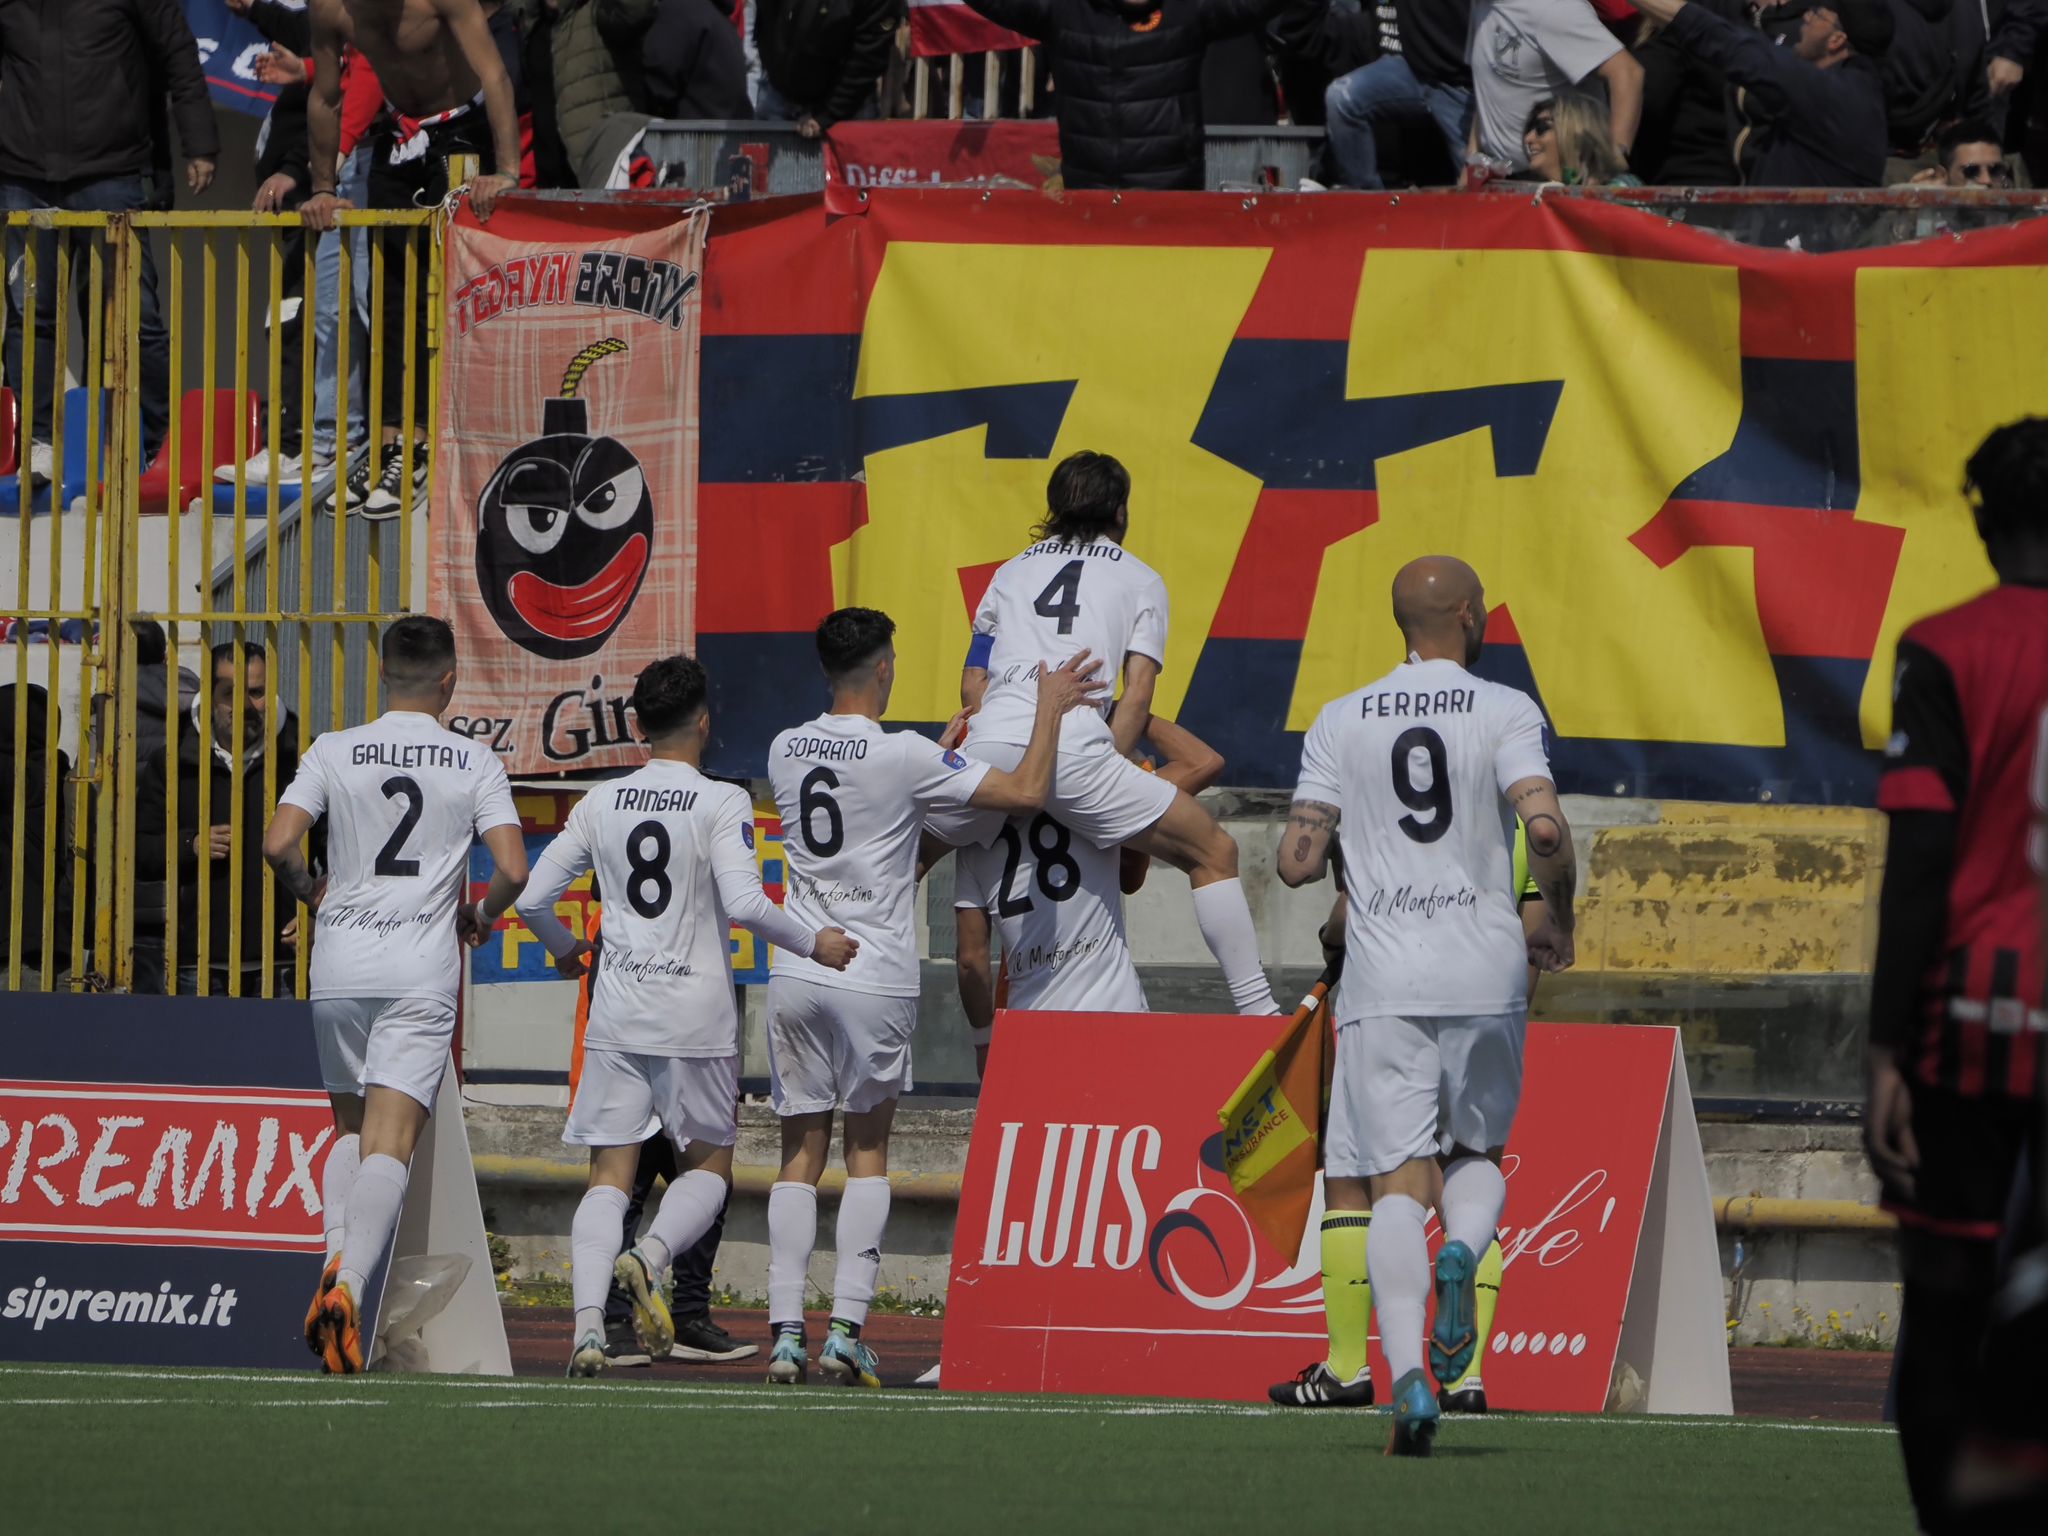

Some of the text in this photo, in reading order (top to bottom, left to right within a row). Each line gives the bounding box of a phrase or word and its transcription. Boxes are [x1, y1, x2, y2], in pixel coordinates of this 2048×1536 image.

[1033, 559, 1085, 635] 4
[1362, 689, 1475, 719] FERRARI
[352, 743, 472, 771] GALLETTA V.
[784, 737, 868, 761] SOPRANO
[1391, 726, 1453, 844] 9
[374, 776, 423, 876] 2
[800, 766, 844, 858] 6
[626, 820, 672, 919] 8
[990, 811, 1081, 919] 28
[1225, 1086, 1275, 1158] NET
[1227, 1108, 1290, 1169] INSURANCE
[979, 1122, 1162, 1270] LUIS
[0, 1276, 237, 1331] sipremix.it
